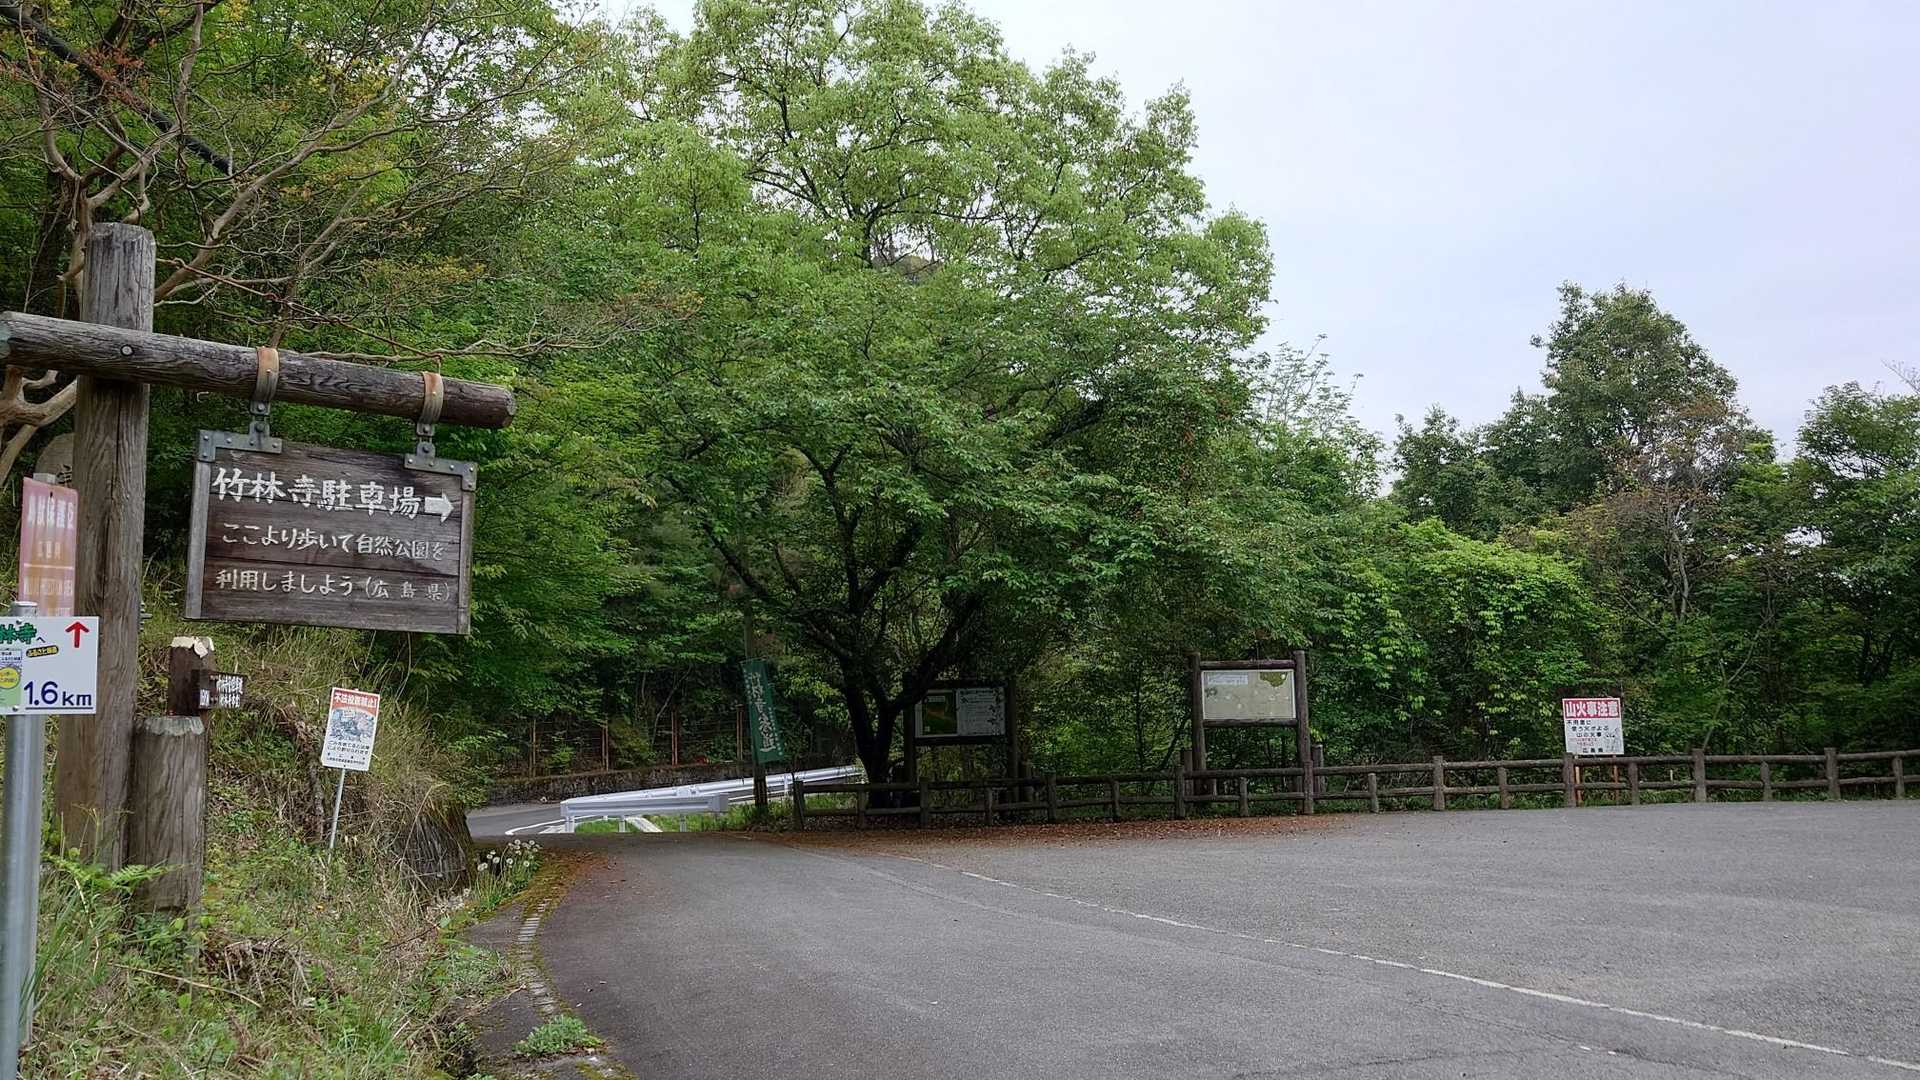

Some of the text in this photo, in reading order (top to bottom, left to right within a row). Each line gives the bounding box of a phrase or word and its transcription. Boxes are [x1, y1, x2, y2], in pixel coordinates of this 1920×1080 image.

[211, 467, 421, 519] 竹林寺駐車場
[222, 523, 446, 560] ここより歩いて自然公園を
[1566, 701, 1619, 717] 山火事注意
